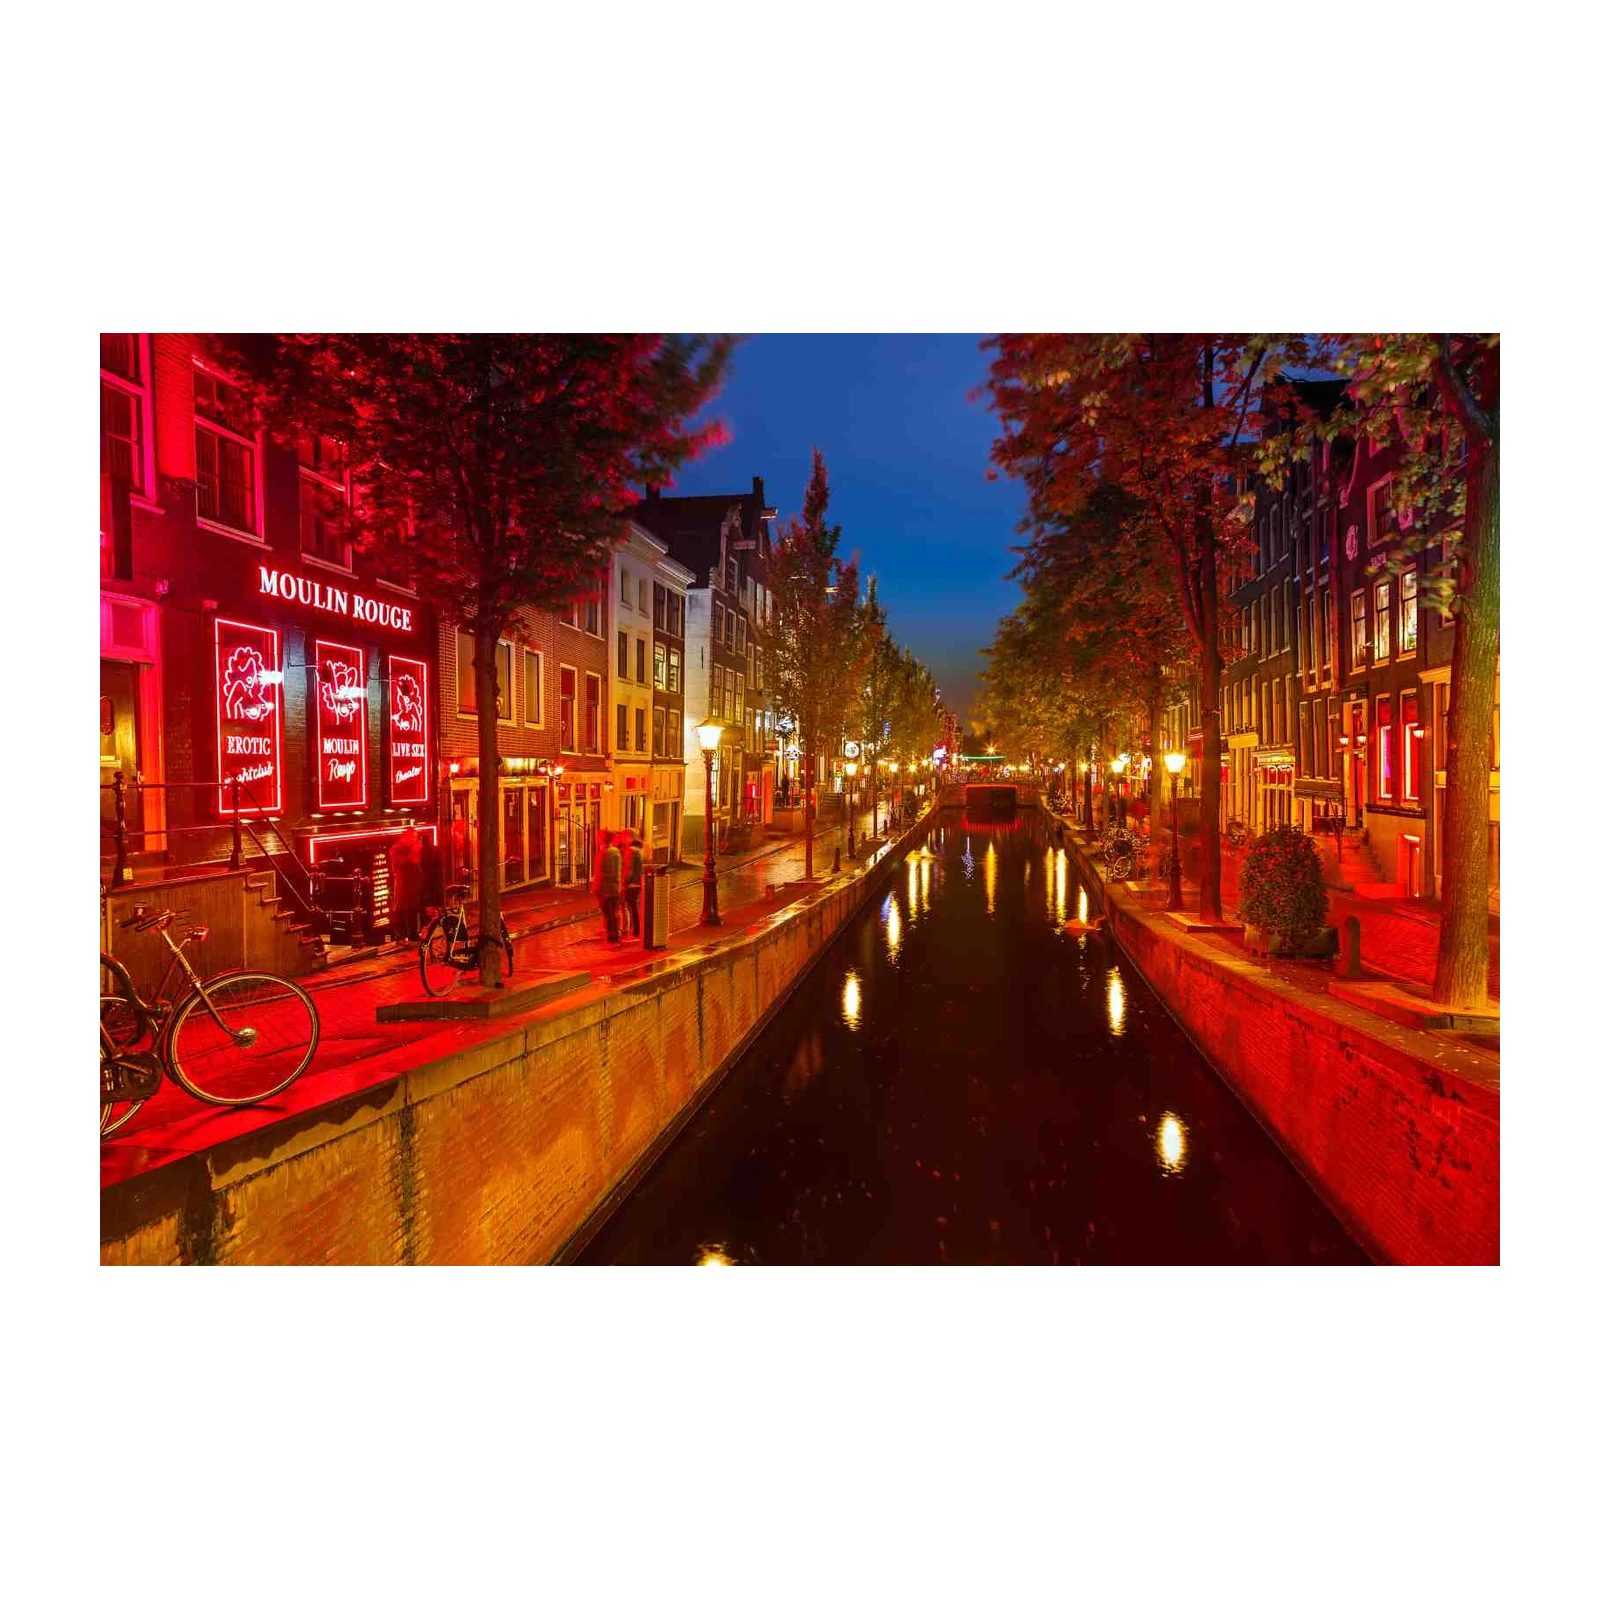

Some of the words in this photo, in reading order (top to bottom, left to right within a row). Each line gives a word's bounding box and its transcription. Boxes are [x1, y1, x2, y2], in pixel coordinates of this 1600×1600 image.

[259, 566, 348, 615] MOULIN
[353, 594, 412, 632] ROUGE
[226, 735, 271, 755] EROTIC
[323, 737, 359, 754] MOULIN
[392, 742, 411, 757] LIVE
[411, 743, 425, 757] SEX
